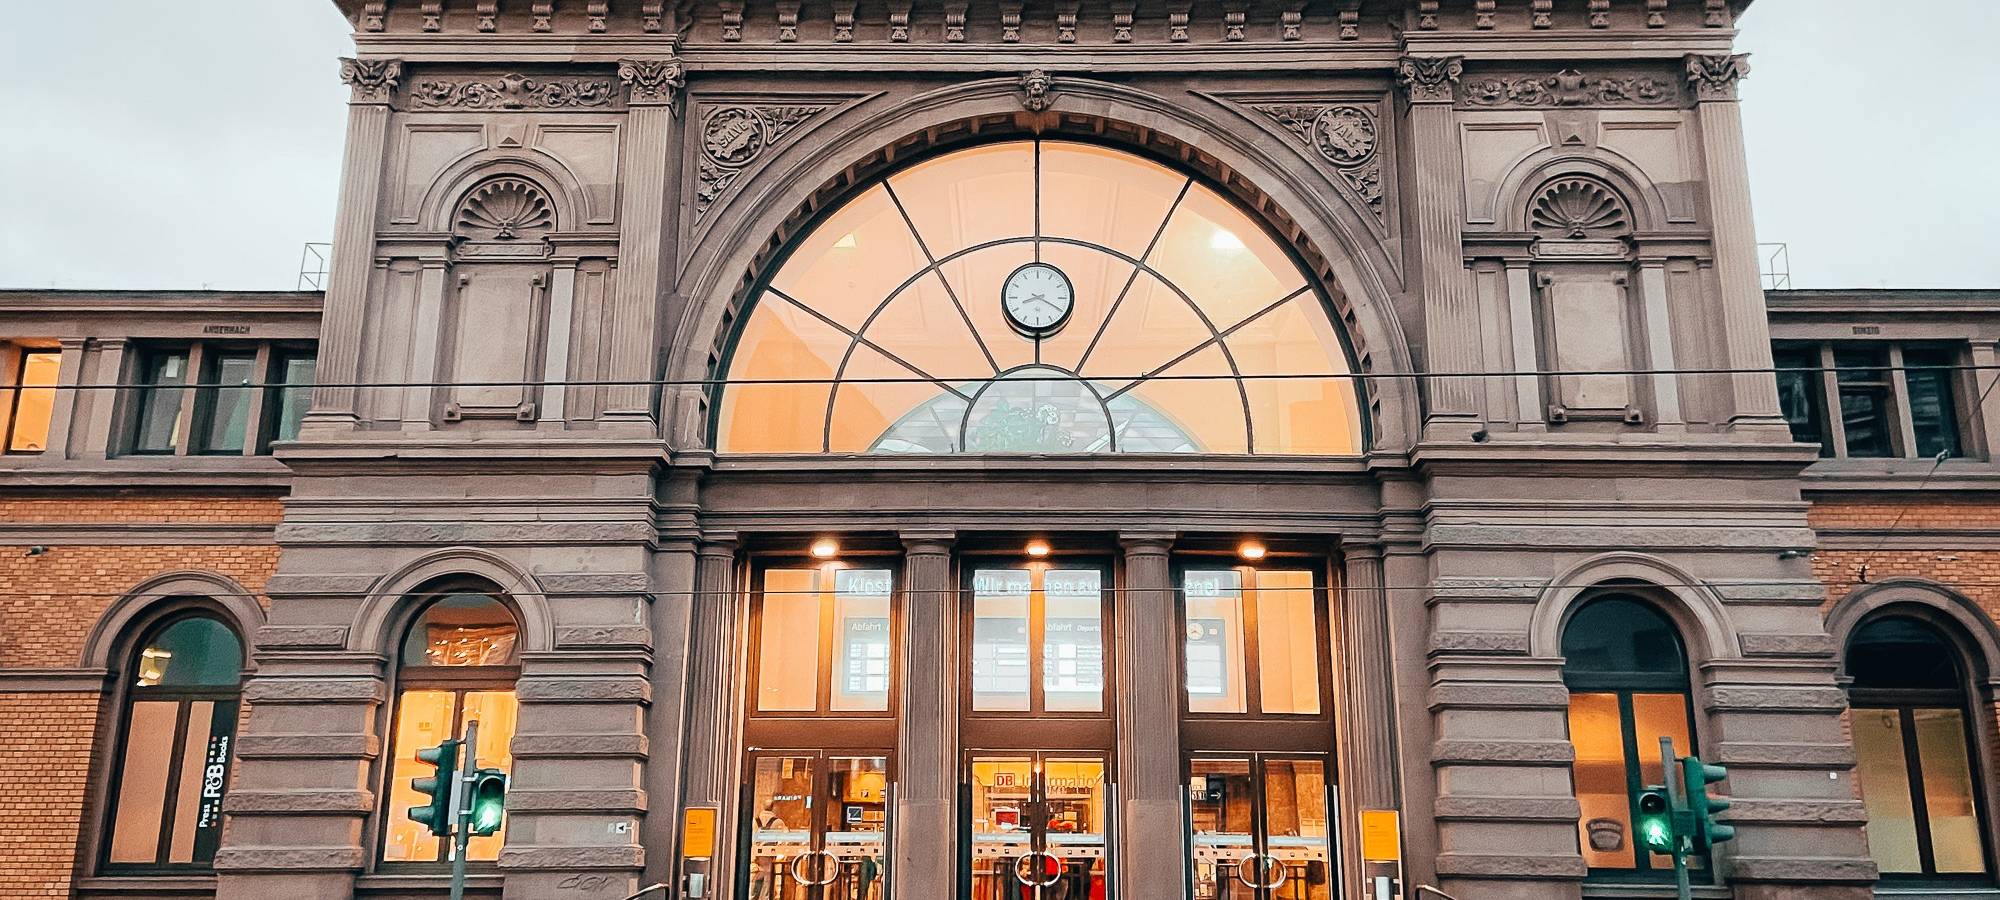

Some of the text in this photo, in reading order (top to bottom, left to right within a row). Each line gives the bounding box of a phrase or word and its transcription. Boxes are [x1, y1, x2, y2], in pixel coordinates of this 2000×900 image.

[719, 120, 749, 148] SALVE
[203, 764, 225, 798] R&B
[216, 736, 229, 763] Books
[996, 775, 1014, 786] DB
